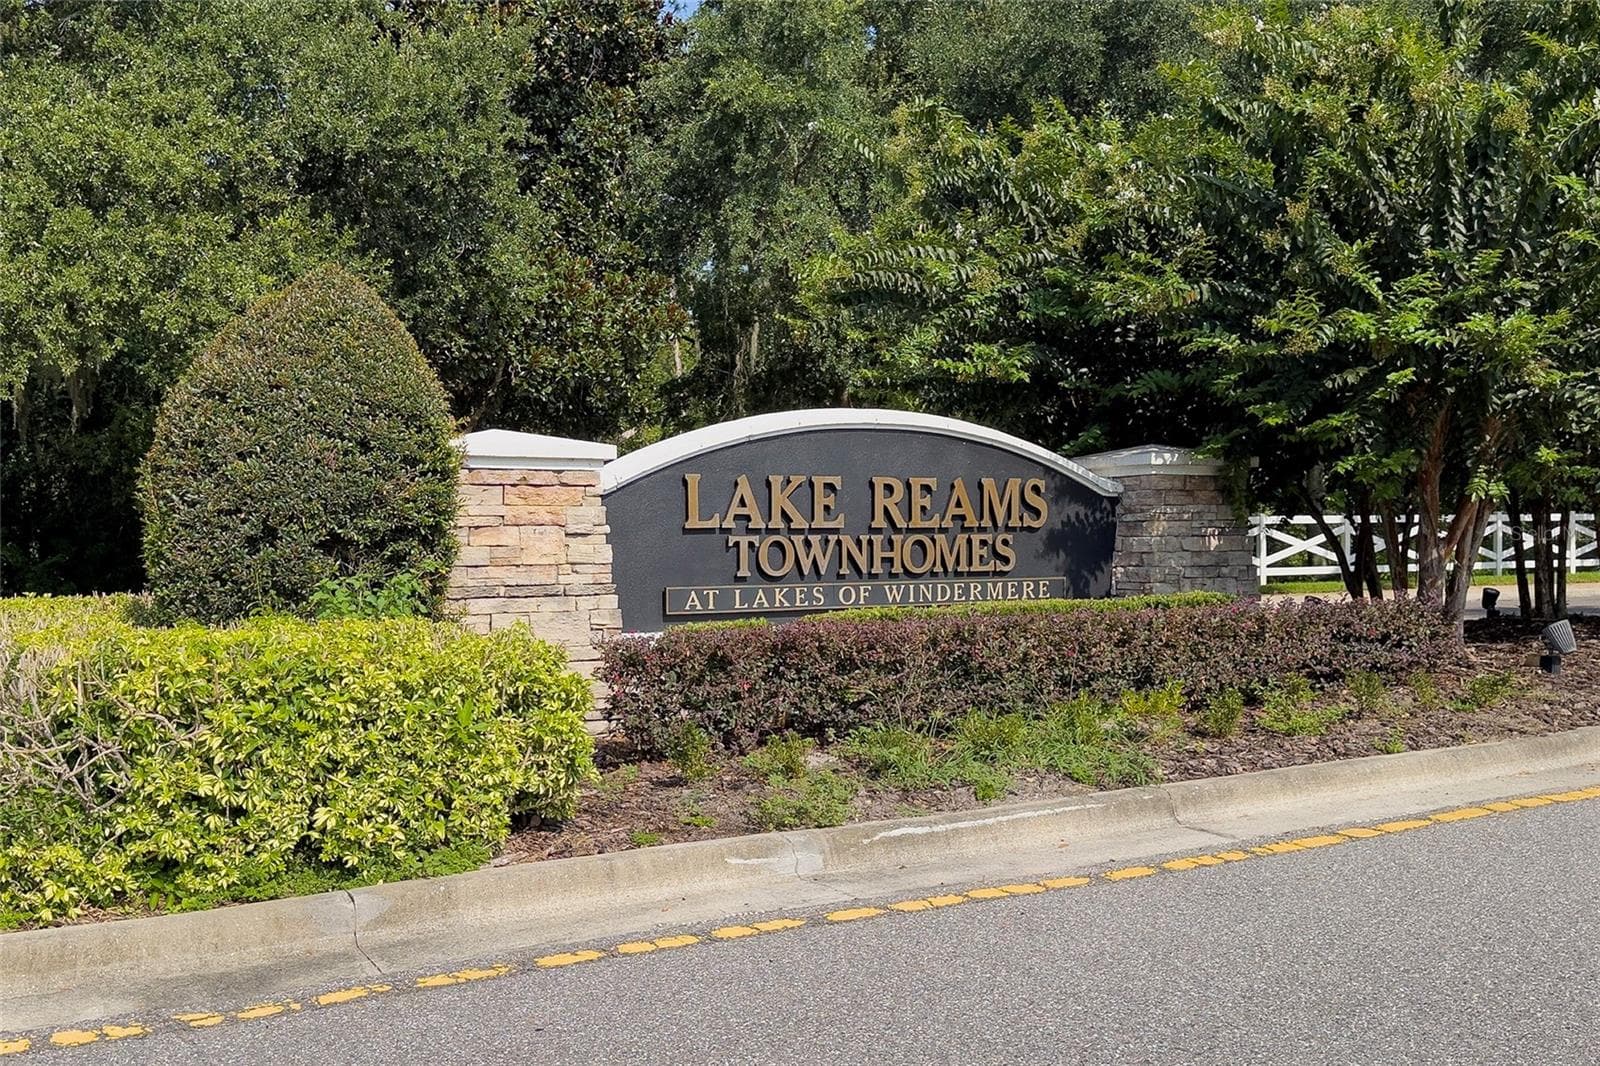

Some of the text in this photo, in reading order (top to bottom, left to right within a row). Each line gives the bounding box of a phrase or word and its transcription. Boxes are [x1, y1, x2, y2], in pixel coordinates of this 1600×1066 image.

[684, 473, 1049, 529] LAKE REAMS
[728, 534, 1017, 577] TOWNHOMES
[684, 580, 1051, 610] AT LAKES OF WINDERMERE
